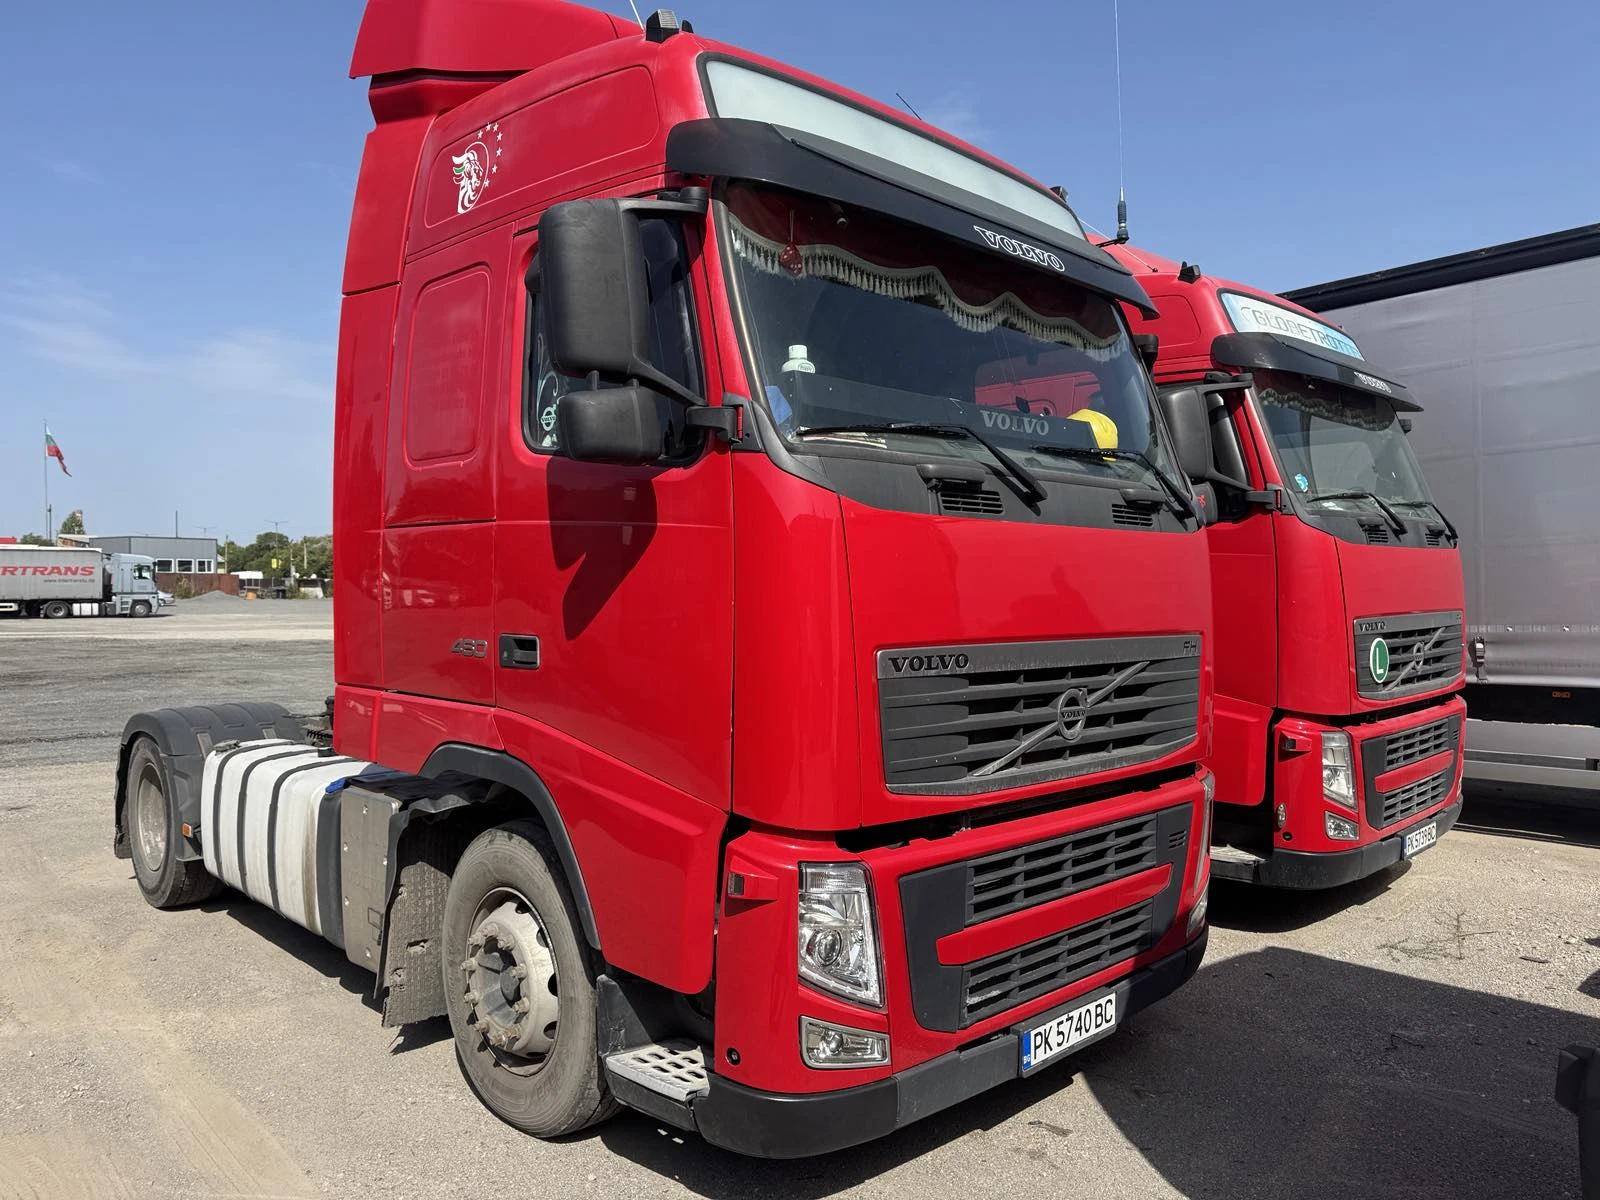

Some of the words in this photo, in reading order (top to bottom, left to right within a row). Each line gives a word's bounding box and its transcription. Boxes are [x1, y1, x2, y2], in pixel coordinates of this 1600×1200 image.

[973, 225, 1065, 272] VOLVO
[980, 410, 1049, 436] VOLVO
[1359, 621, 1386, 632] VOLVO
[1183, 641, 1198, 656] FH
[888, 653, 969, 673] VOLVO
[1061, 710, 1086, 719] VOLVO
[1034, 1025, 1053, 1060] PK
[1056, 1008, 1092, 1048] 5740
[1095, 998, 1113, 1030] BC
